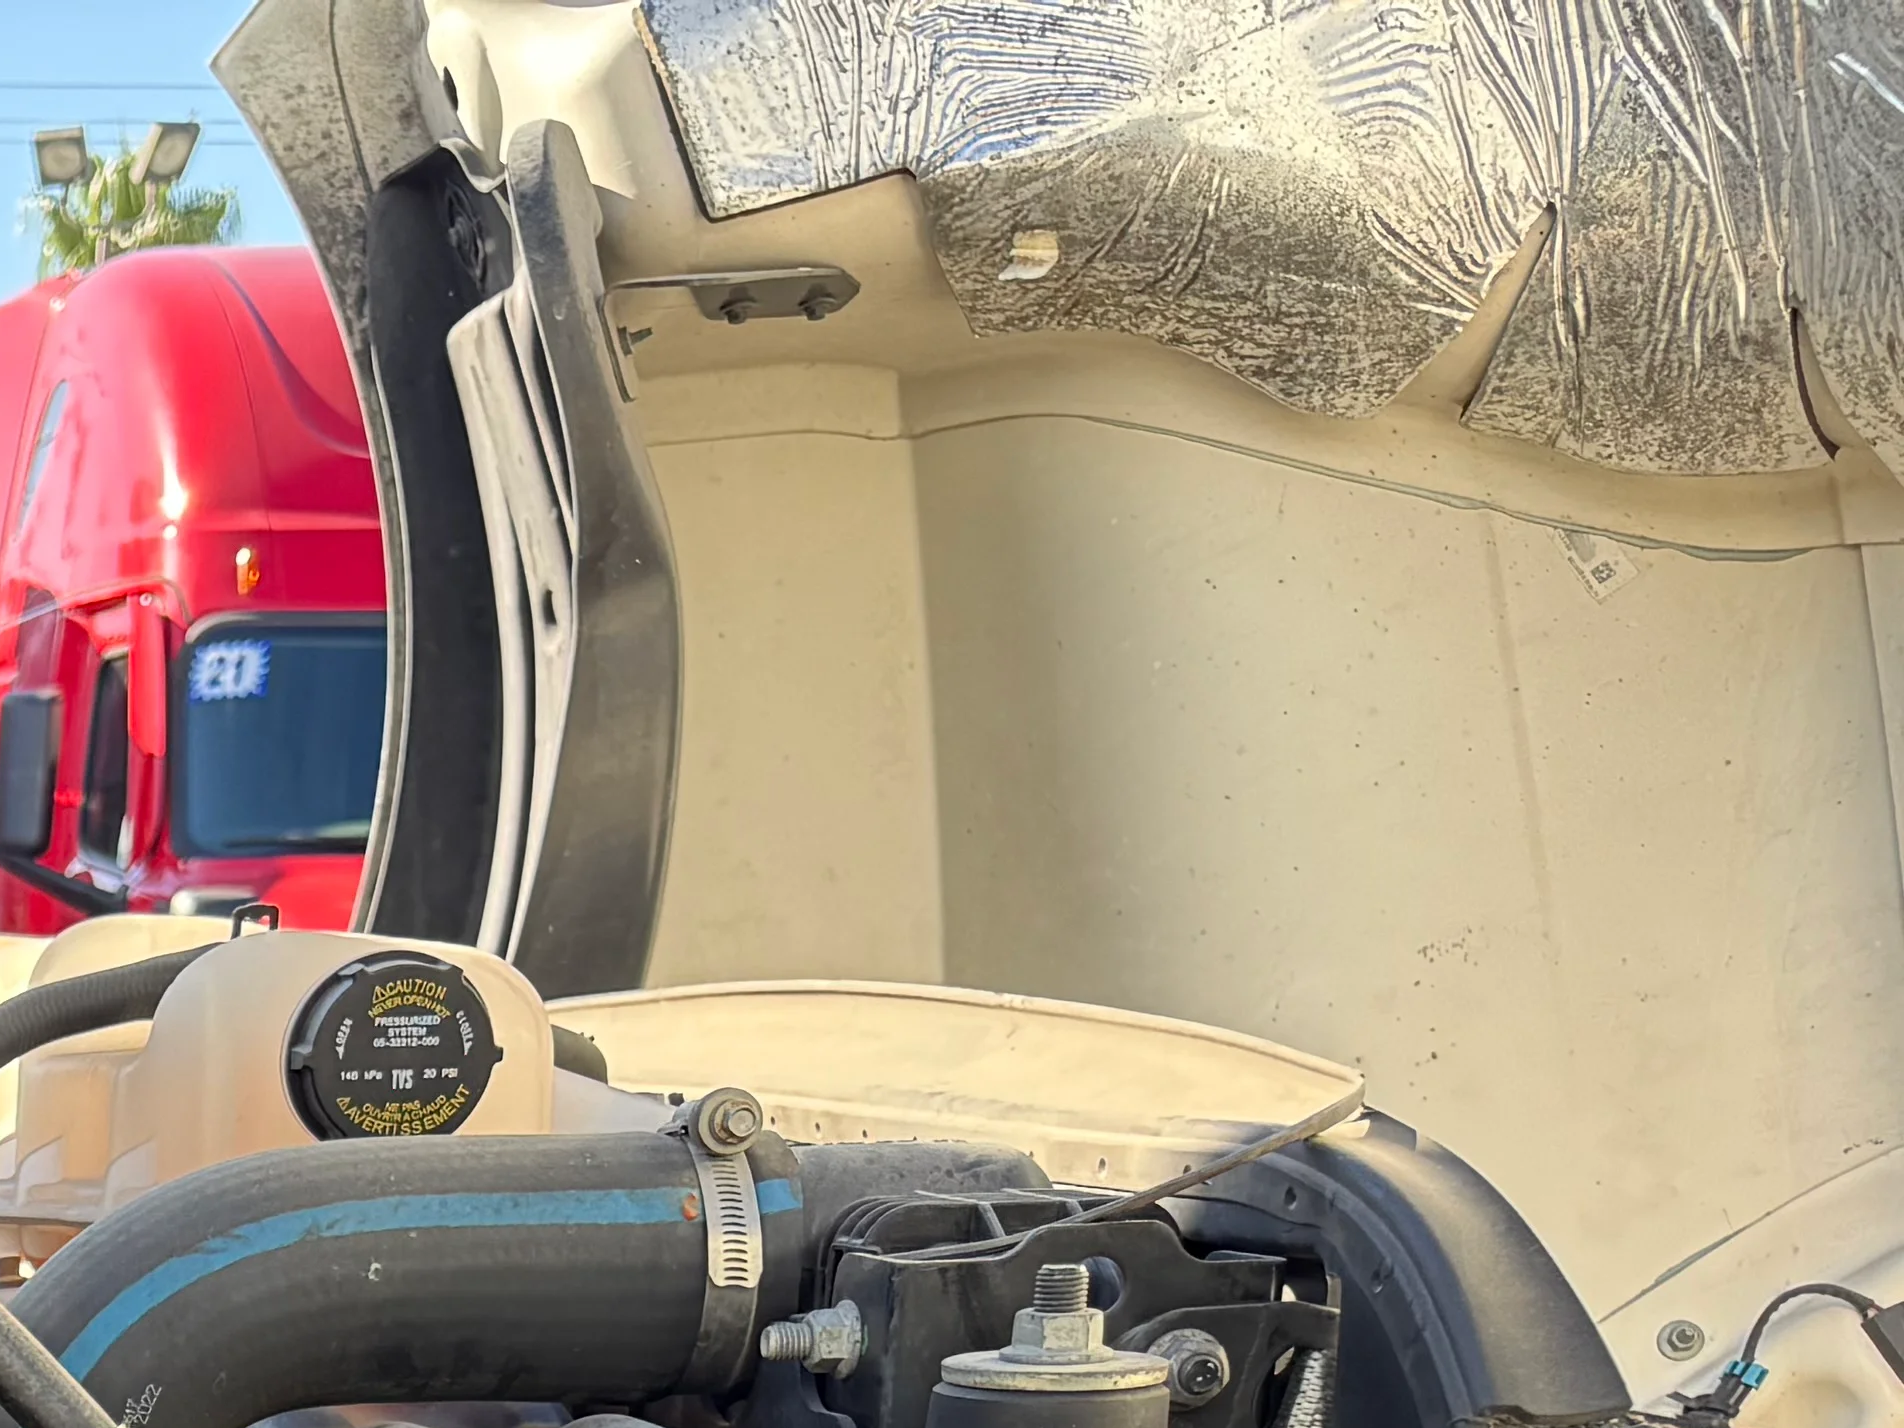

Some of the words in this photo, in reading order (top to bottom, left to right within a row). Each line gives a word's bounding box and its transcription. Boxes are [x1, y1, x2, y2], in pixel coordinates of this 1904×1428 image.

[386, 978, 447, 1000] CAUTION
[388, 1026, 427, 1037] SYSTEM
[391, 1068, 414, 1090] TVS
[441, 1067, 458, 1078] PSI
